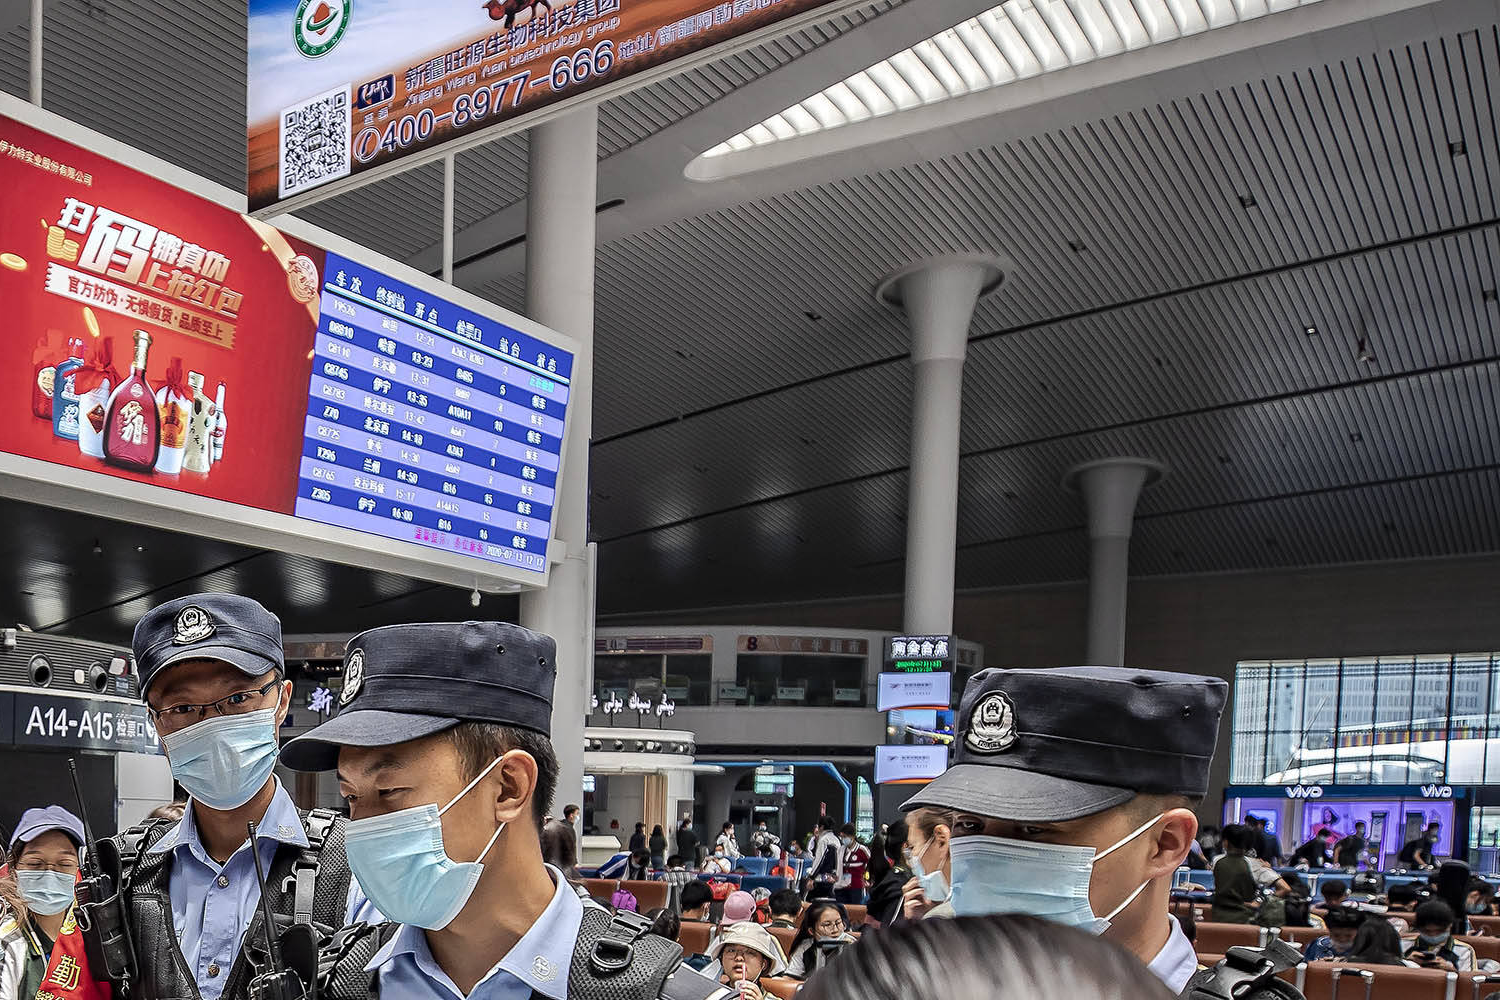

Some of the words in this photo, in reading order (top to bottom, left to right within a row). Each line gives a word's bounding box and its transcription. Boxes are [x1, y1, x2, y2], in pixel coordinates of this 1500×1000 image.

[587, 16, 620, 39] group
[380, 39, 615, 153] 400-8977-666
[307, 686, 334, 716] 新
[25, 705, 114, 740] A14-A15
[116, 718, 145, 738] 检票口
[1285, 784, 1324, 798] vivo
[1421, 784, 1453, 798] vivo
[48, 954, 81, 991] 勤
